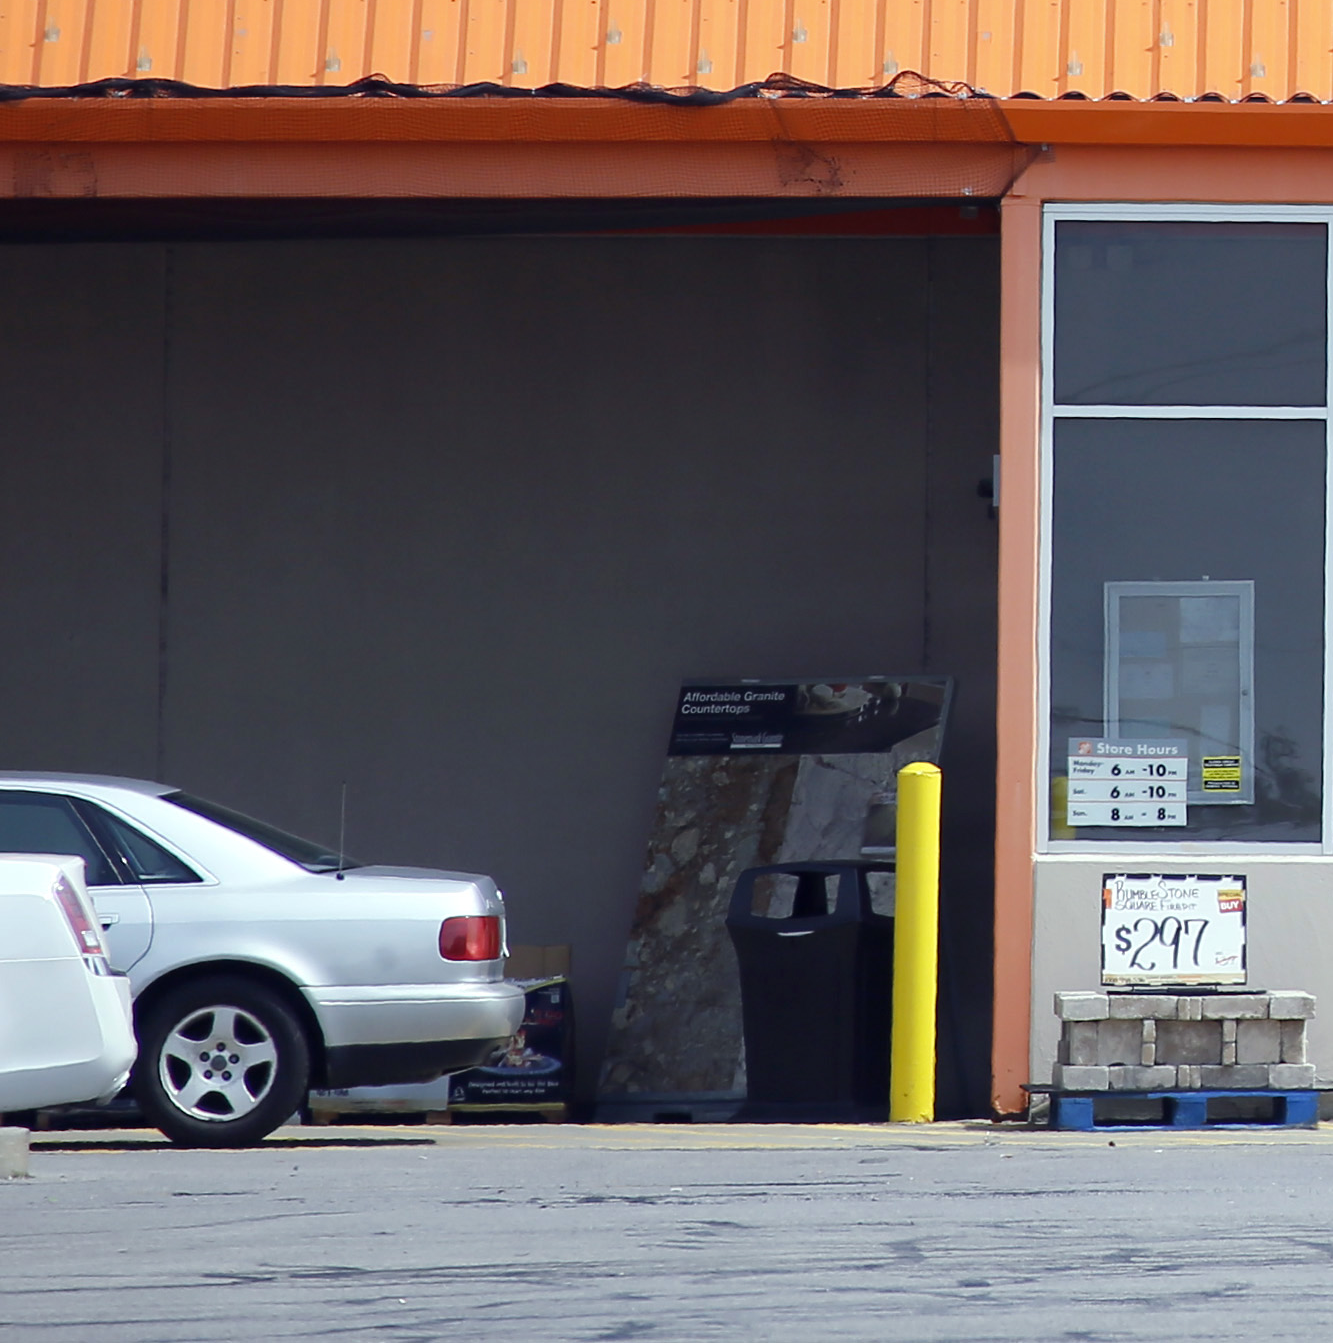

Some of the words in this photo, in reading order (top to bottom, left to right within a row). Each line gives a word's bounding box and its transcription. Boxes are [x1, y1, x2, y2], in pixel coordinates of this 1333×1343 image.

[683, 691, 741, 702] Affordable
[744, 691, 785, 701] Granite
[681, 704, 751, 715] Countertops
[1096, 743, 1132, 754] Store
[1137, 744, 1178, 755] Hours
[1073, 767, 1095, 775] Friday
[1111, 764, 1121, 776] 6
[1110, 786, 1120, 799] 6
[1111, 808, 1120, 821] 8
[1157, 808, 1166, 820] 8
[1115, 898, 1159, 911] SQUARE
[1220, 901, 1239, 910] BUY
[1115, 916, 1210, 971] $297
